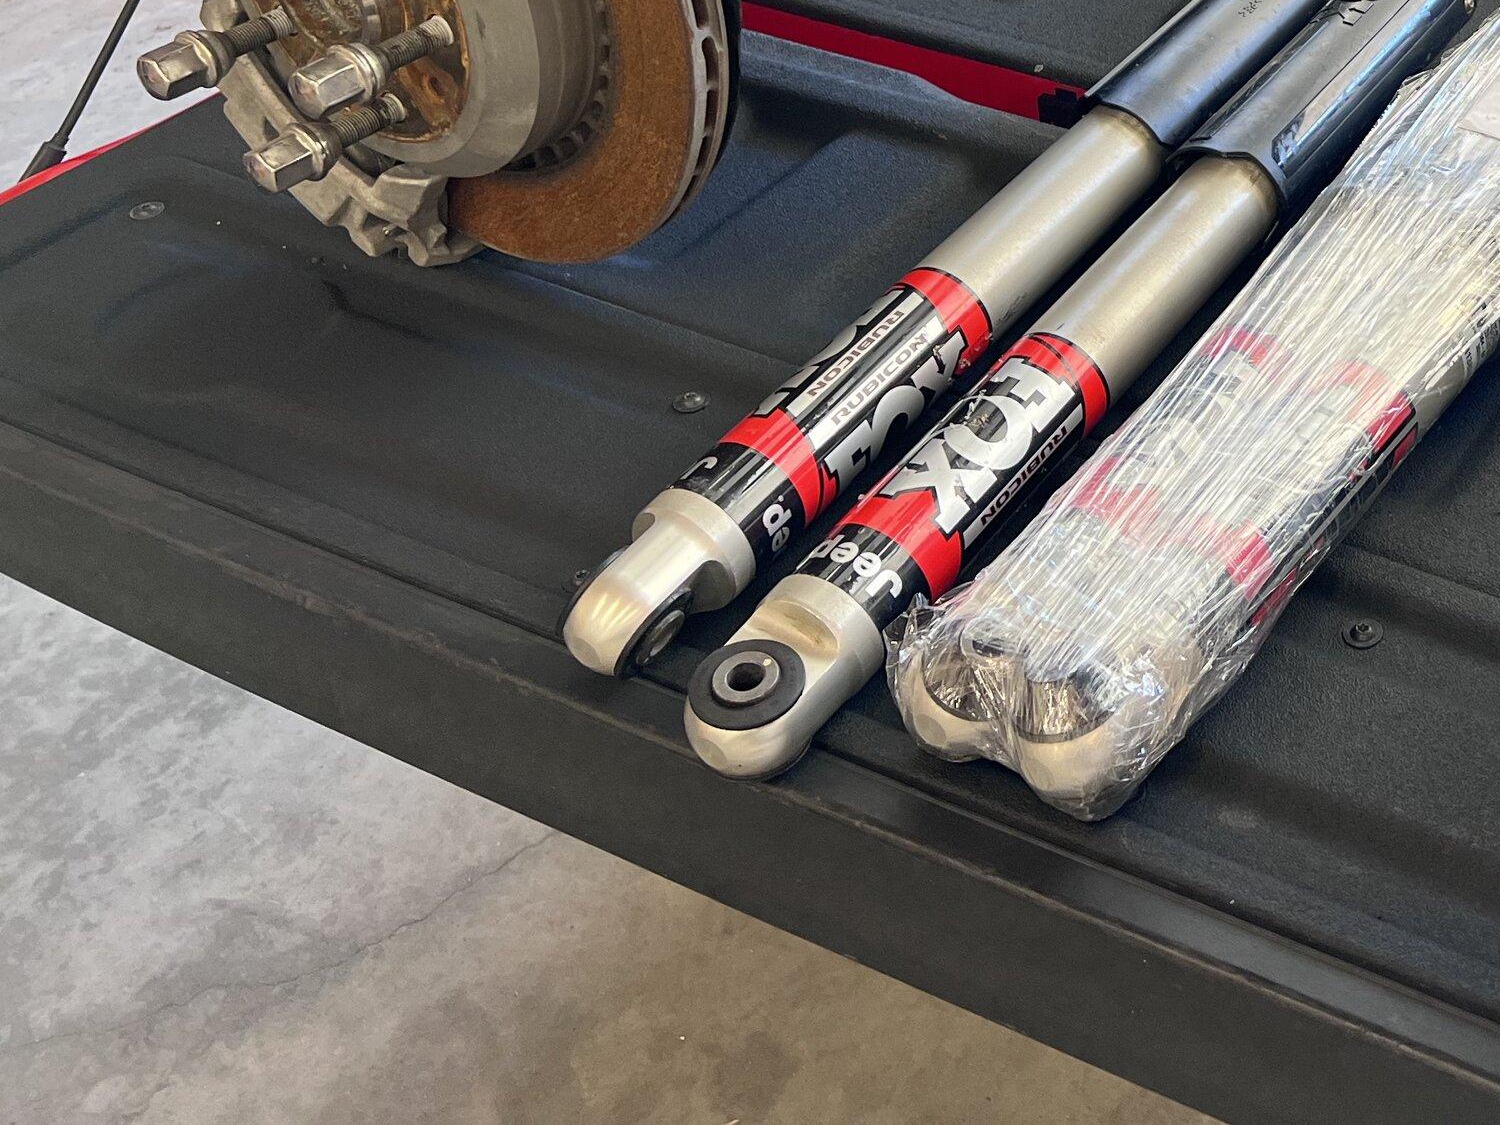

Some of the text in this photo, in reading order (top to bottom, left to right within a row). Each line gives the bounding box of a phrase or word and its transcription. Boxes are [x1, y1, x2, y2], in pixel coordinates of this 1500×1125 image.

[807, 309, 906, 398] RUBICON
[830, 331, 929, 427] RUBICON
[879, 357, 1077, 535] FOX
[979, 425, 1069, 527] RUBICON
[810, 533, 903, 599] Jeep
